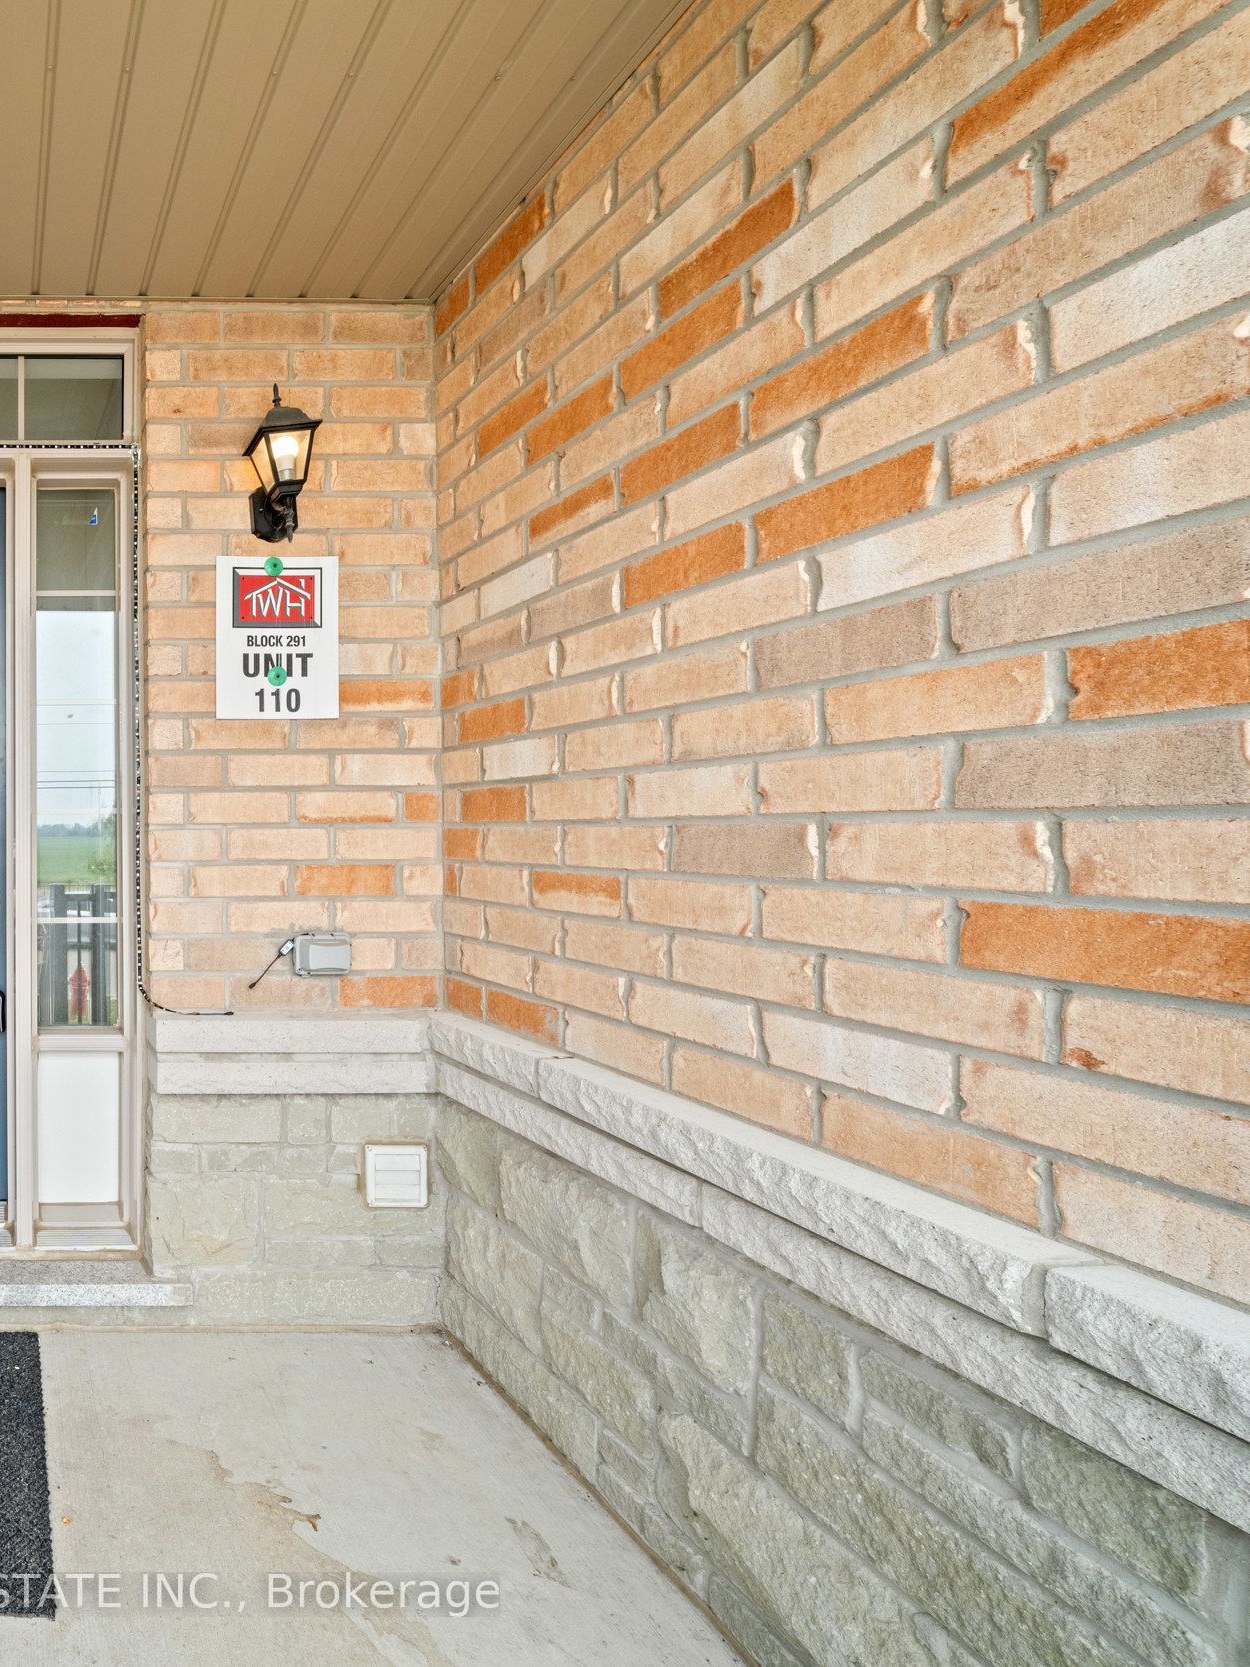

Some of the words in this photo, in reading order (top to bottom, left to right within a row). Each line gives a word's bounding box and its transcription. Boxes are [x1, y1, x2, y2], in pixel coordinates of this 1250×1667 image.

[246, 635, 283, 647] BLOCK
[286, 635, 306, 647] 291
[242, 653, 313, 678] UNIT
[255, 688, 301, 712] 110
